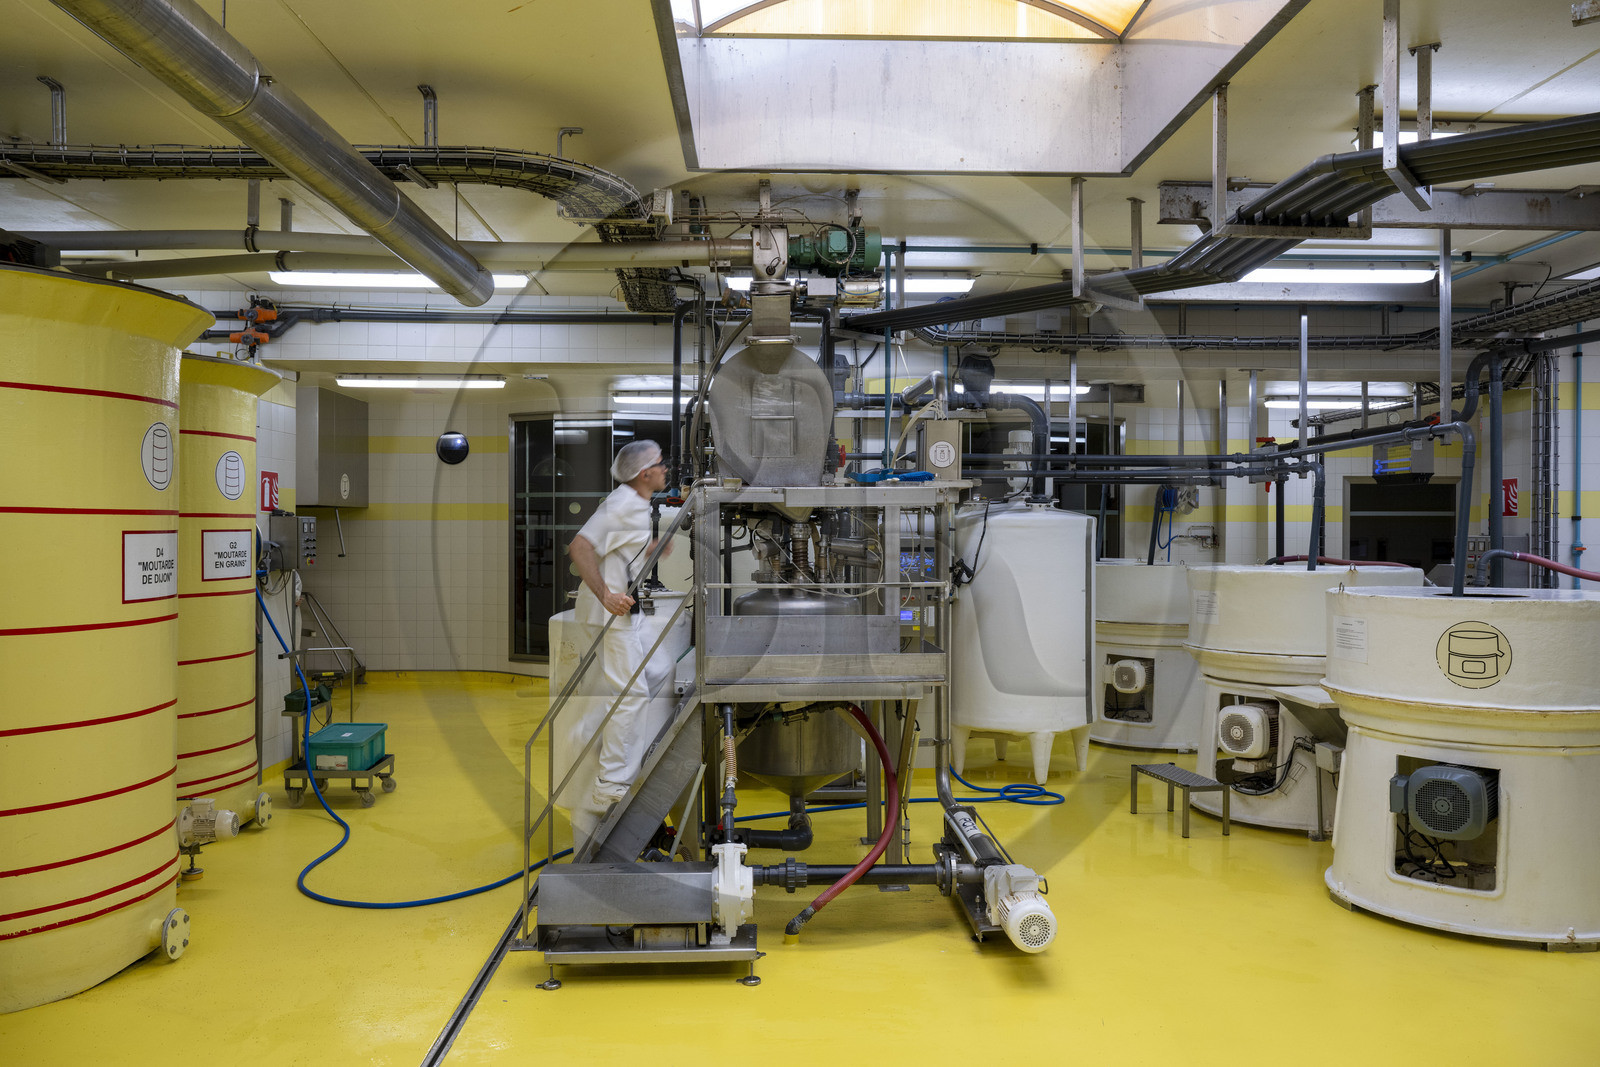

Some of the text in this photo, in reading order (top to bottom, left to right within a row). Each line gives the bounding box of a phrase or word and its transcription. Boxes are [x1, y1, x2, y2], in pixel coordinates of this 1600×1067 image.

[229, 541, 237, 550] G2
[156, 547, 164, 558] D4
[214, 550, 247, 559] "MOUTARDE
[138, 559, 174, 571] "MOUTARDE
[214, 559, 247, 569] EN GRAINS"
[142, 572, 172, 585] DE DIJON"
